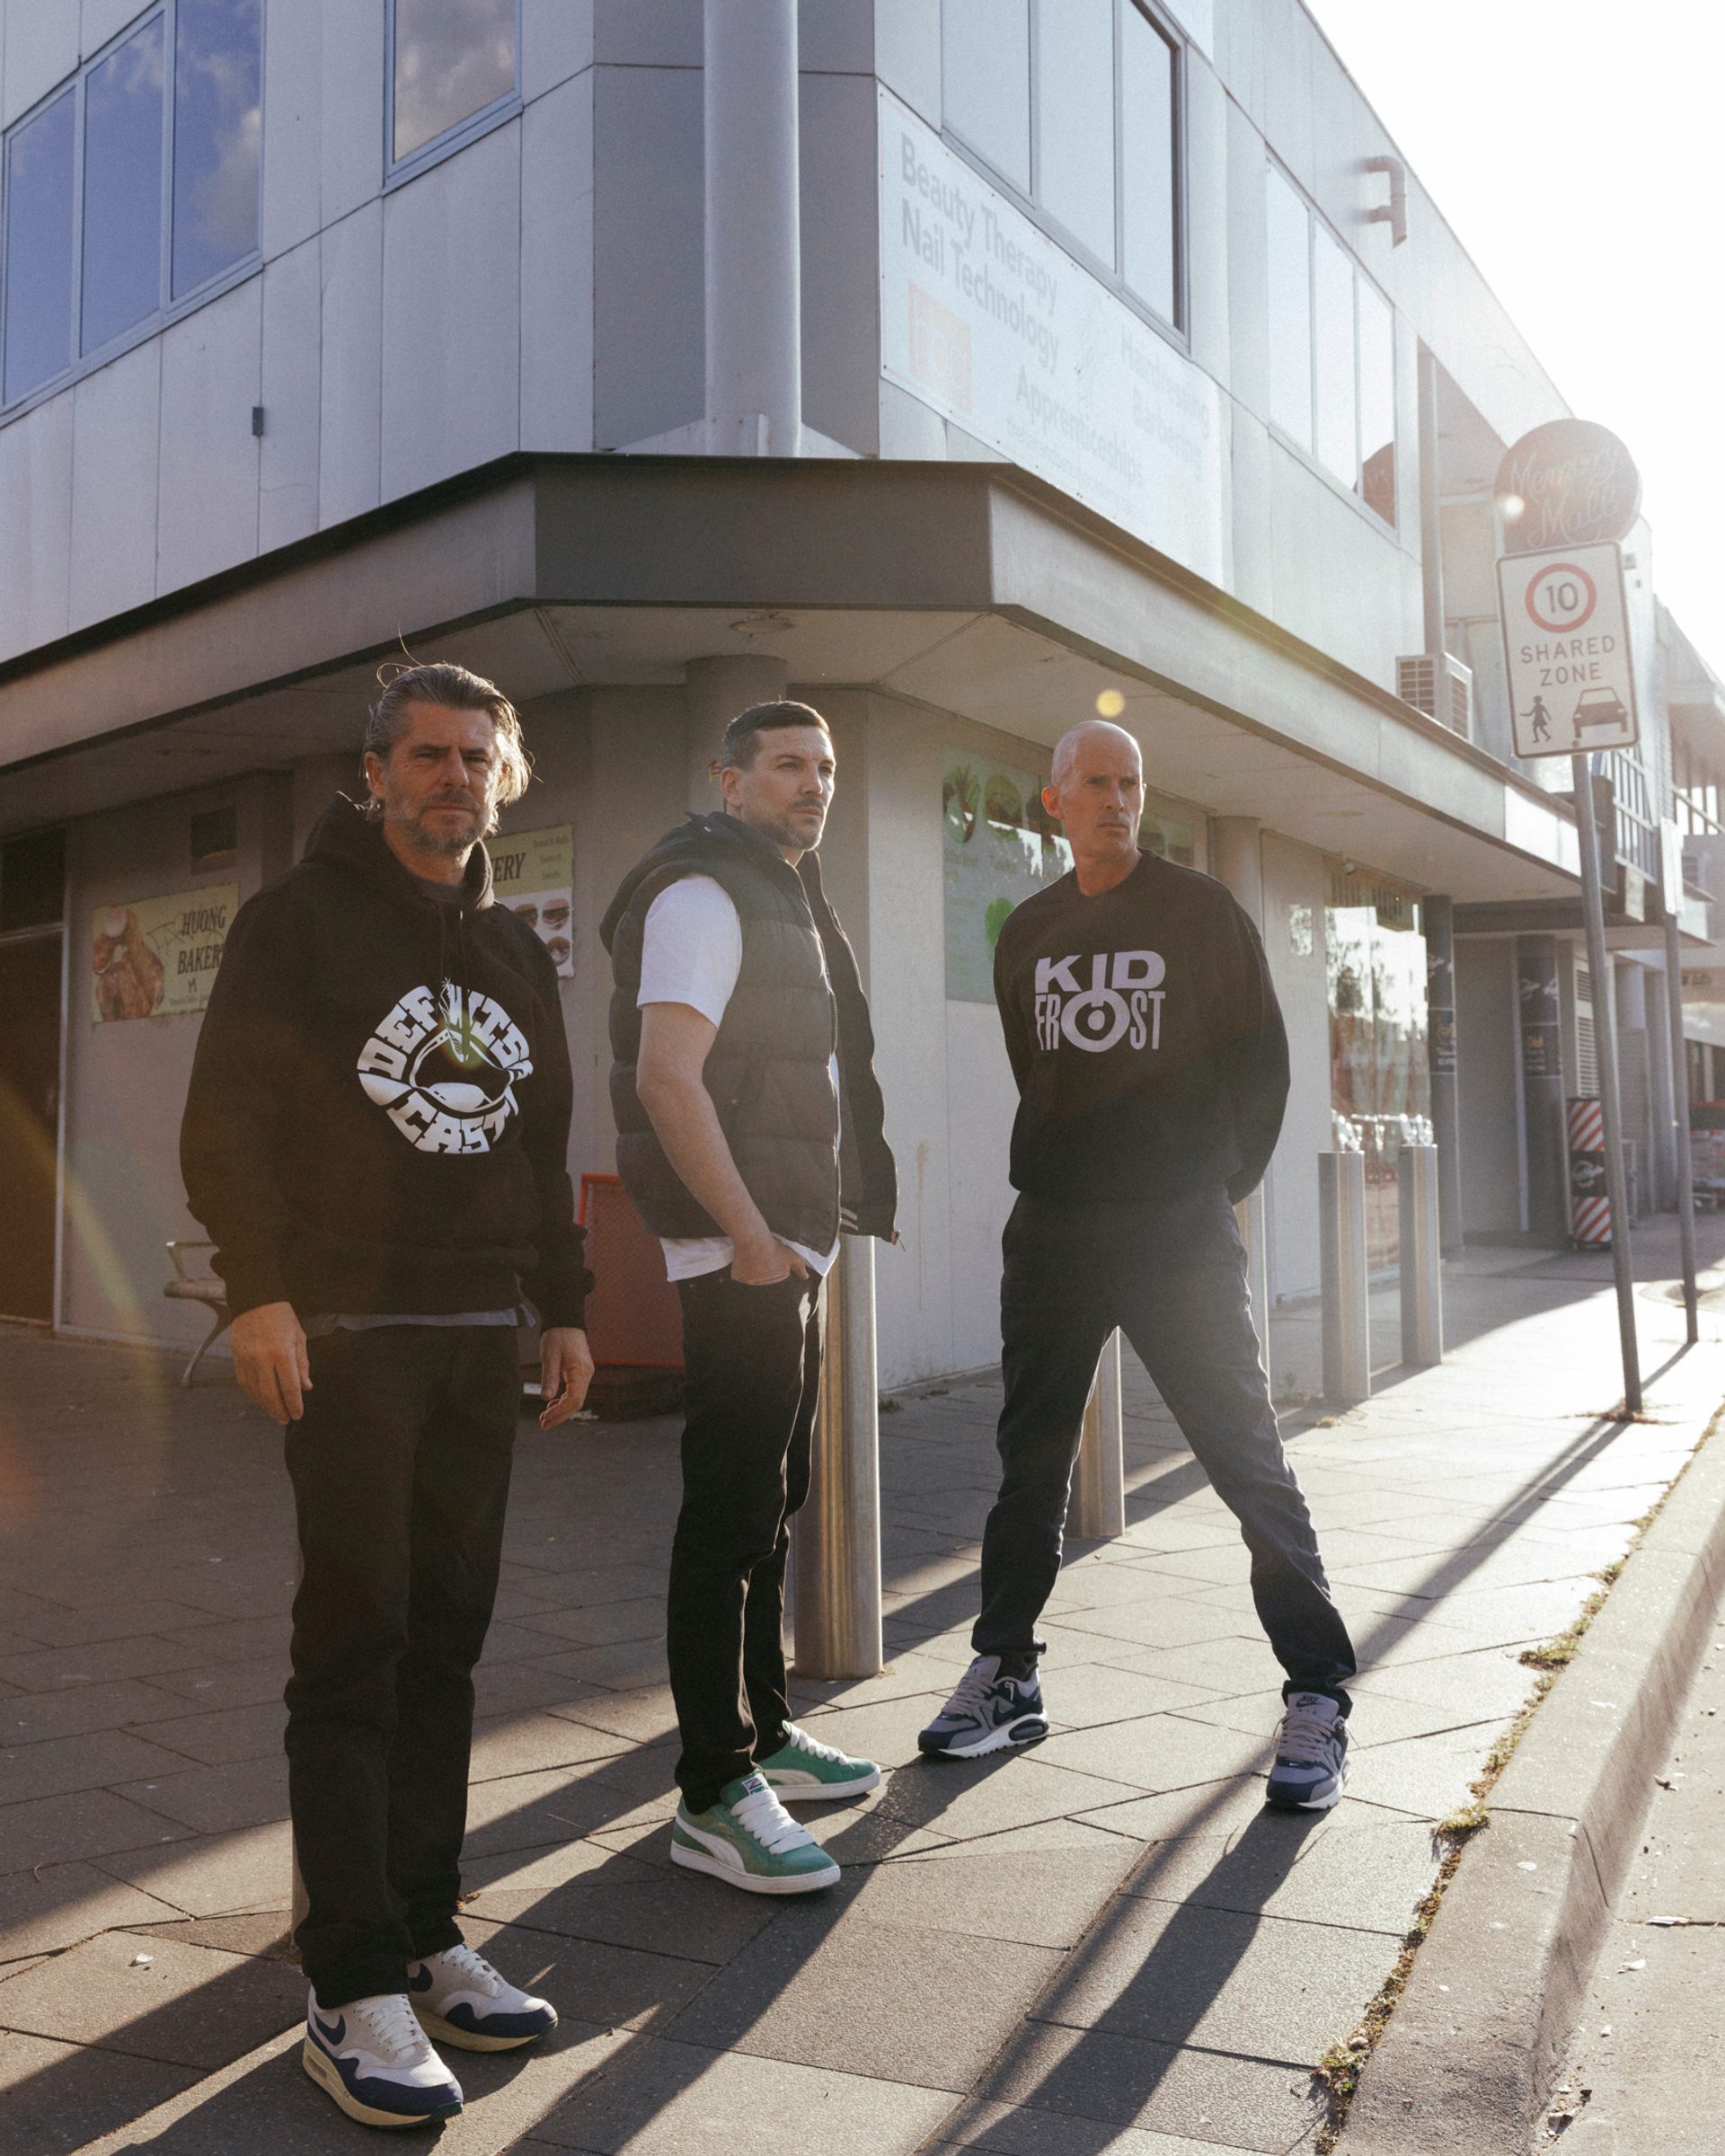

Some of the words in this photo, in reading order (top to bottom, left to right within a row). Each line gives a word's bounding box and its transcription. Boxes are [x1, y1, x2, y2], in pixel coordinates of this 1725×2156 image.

[901, 132, 975, 249] Beauty
[980, 204, 1058, 316] Therapy
[901, 198, 945, 276] Nail
[950, 240, 1059, 375] Technology
[1121, 325, 1210, 440] Hairdressing
[1015, 363, 1143, 490] Apprenticeships
[1133, 386, 1203, 482] Barbering
[1545, 581, 1579, 614] 10
[1521, 635, 1615, 664] SHARED
[1540, 661, 1603, 686] ZONE
[491, 853, 526, 882] ERY
[181, 906, 227, 936] HUONG
[178, 944, 225, 974] BAKER
[1035, 950, 1166, 999] KID
[357, 985, 439, 1081] DEF
[1035, 988, 1166, 1053] FROST
[385, 1091, 512, 1154] CAST
